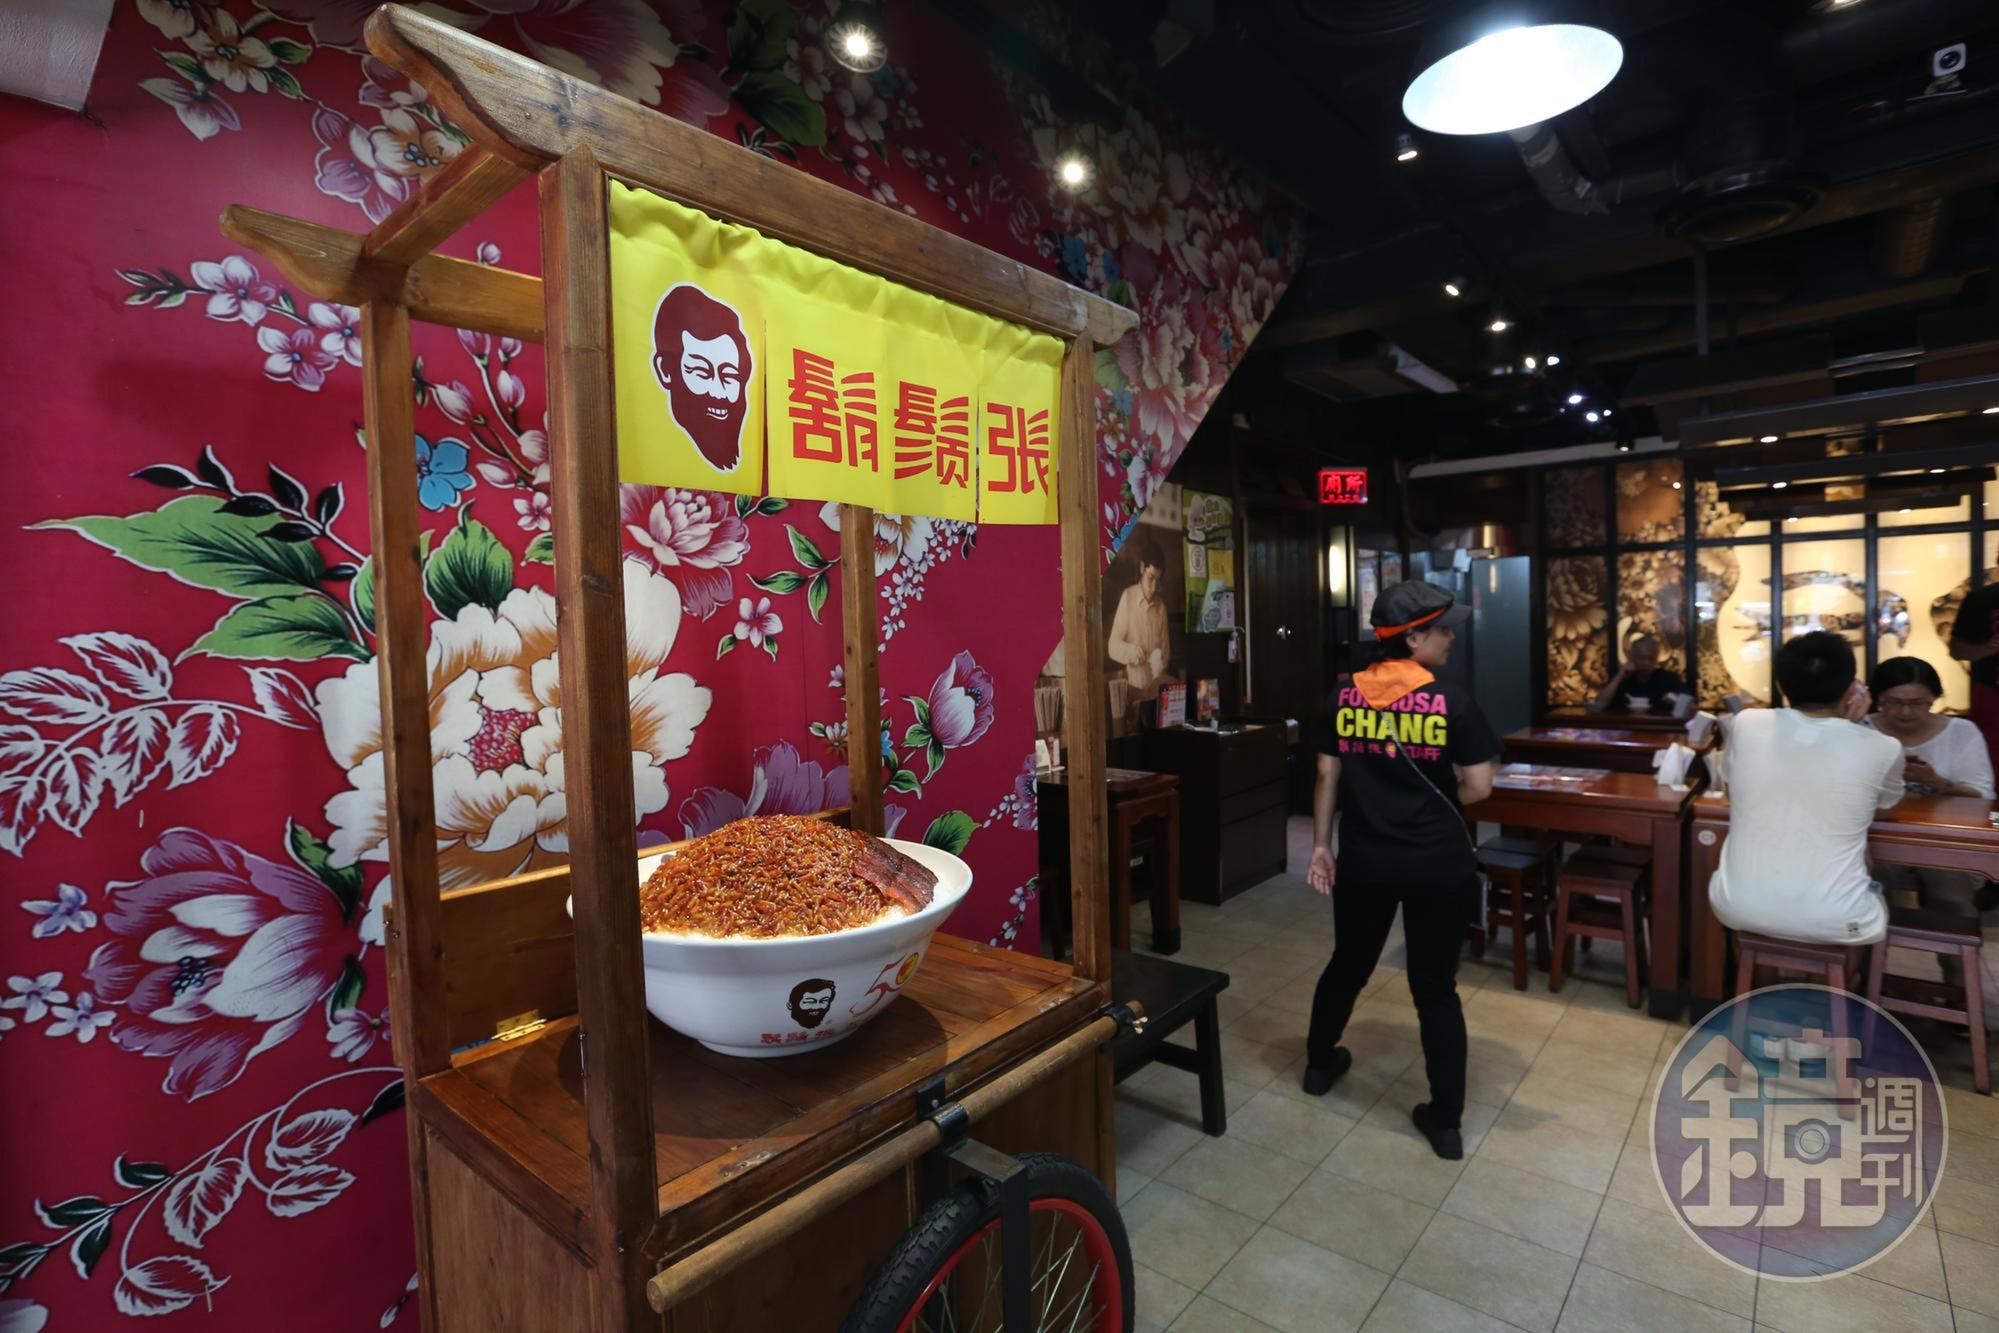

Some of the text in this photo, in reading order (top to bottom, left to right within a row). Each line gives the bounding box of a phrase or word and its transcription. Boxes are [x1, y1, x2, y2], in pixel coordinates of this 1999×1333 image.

[788, 348, 1049, 497] 鬍鬚張
[1339, 688, 1447, 714] FOOSA
[1337, 708, 1447, 745] CHANG
